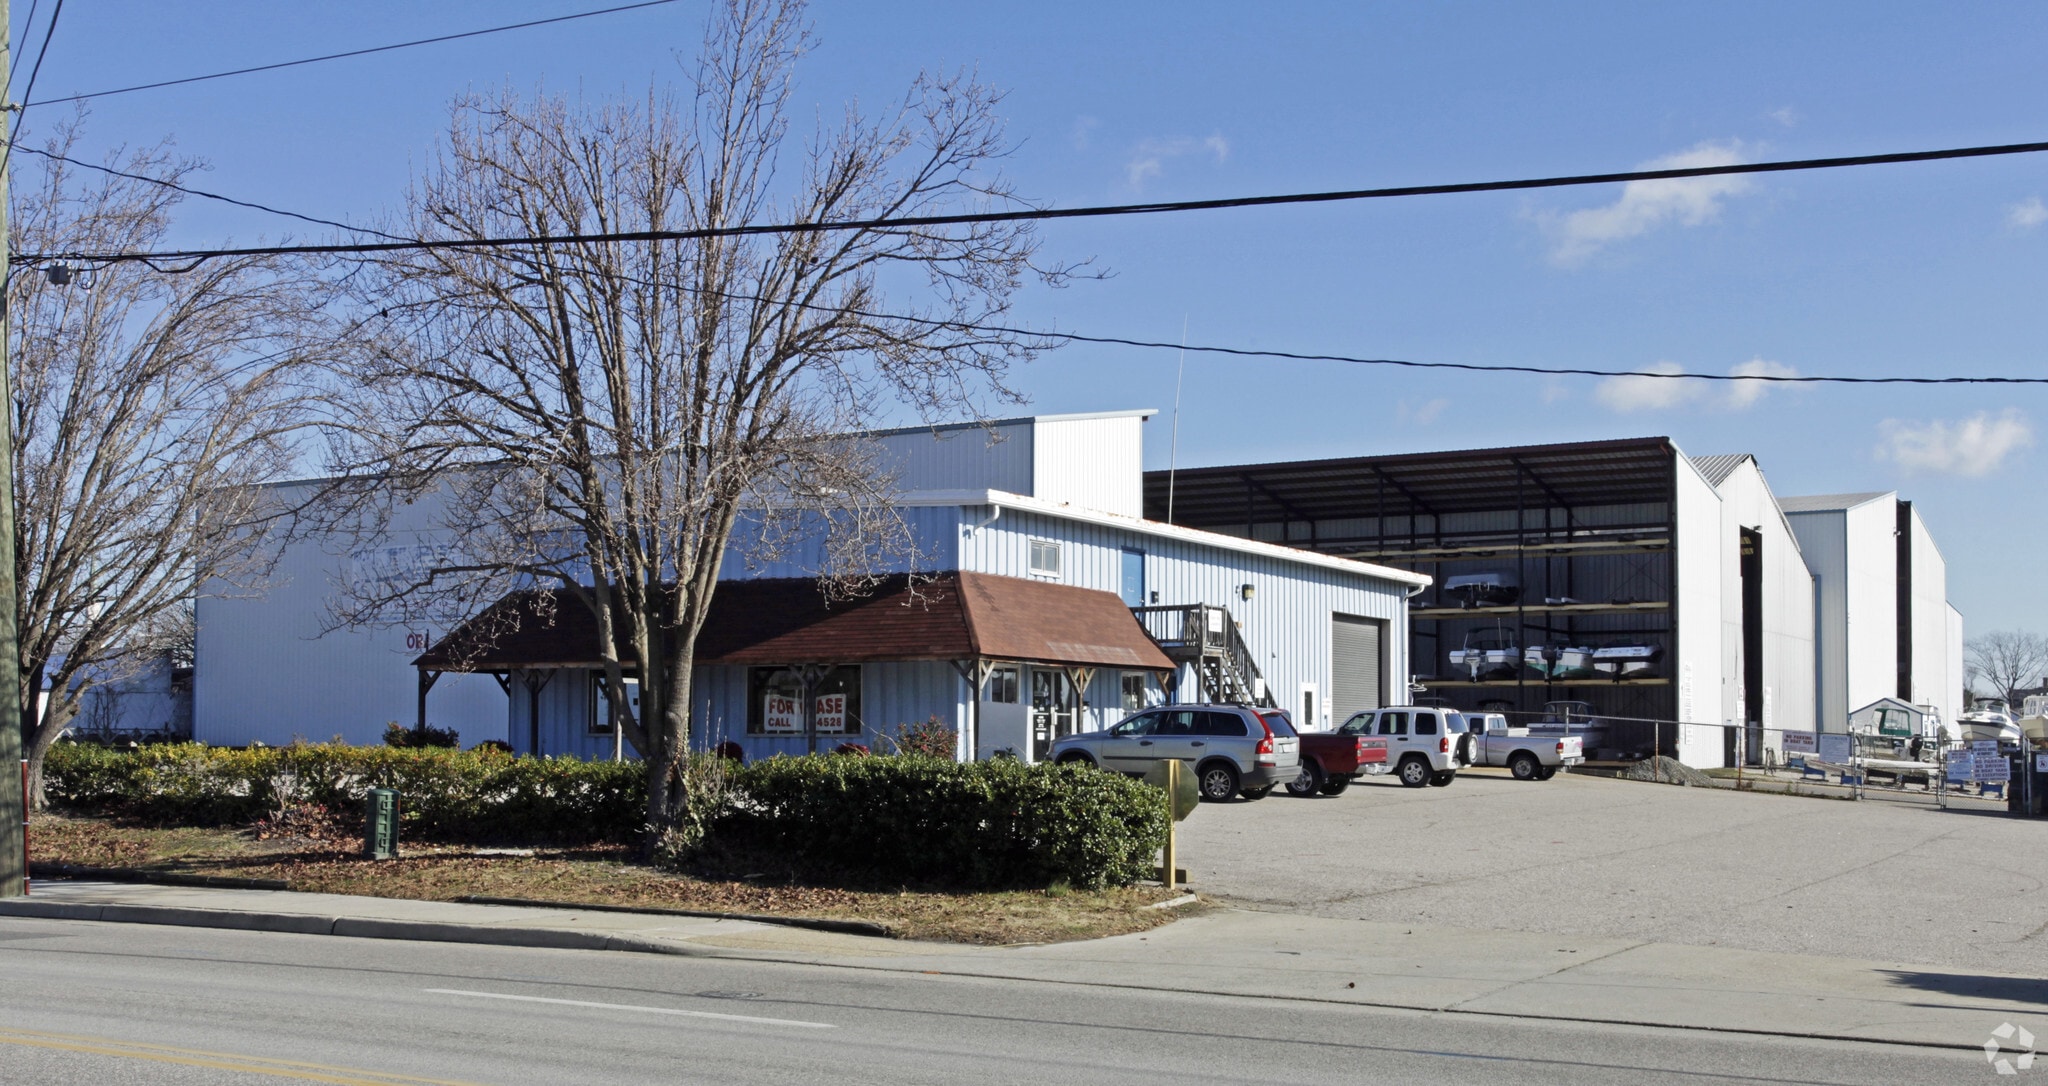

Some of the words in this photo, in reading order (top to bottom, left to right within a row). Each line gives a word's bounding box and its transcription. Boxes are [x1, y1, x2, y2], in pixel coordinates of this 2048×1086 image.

[769, 699, 795, 714] FOR
[768, 718, 791, 726] CALL
[817, 718, 842, 726] 4528
